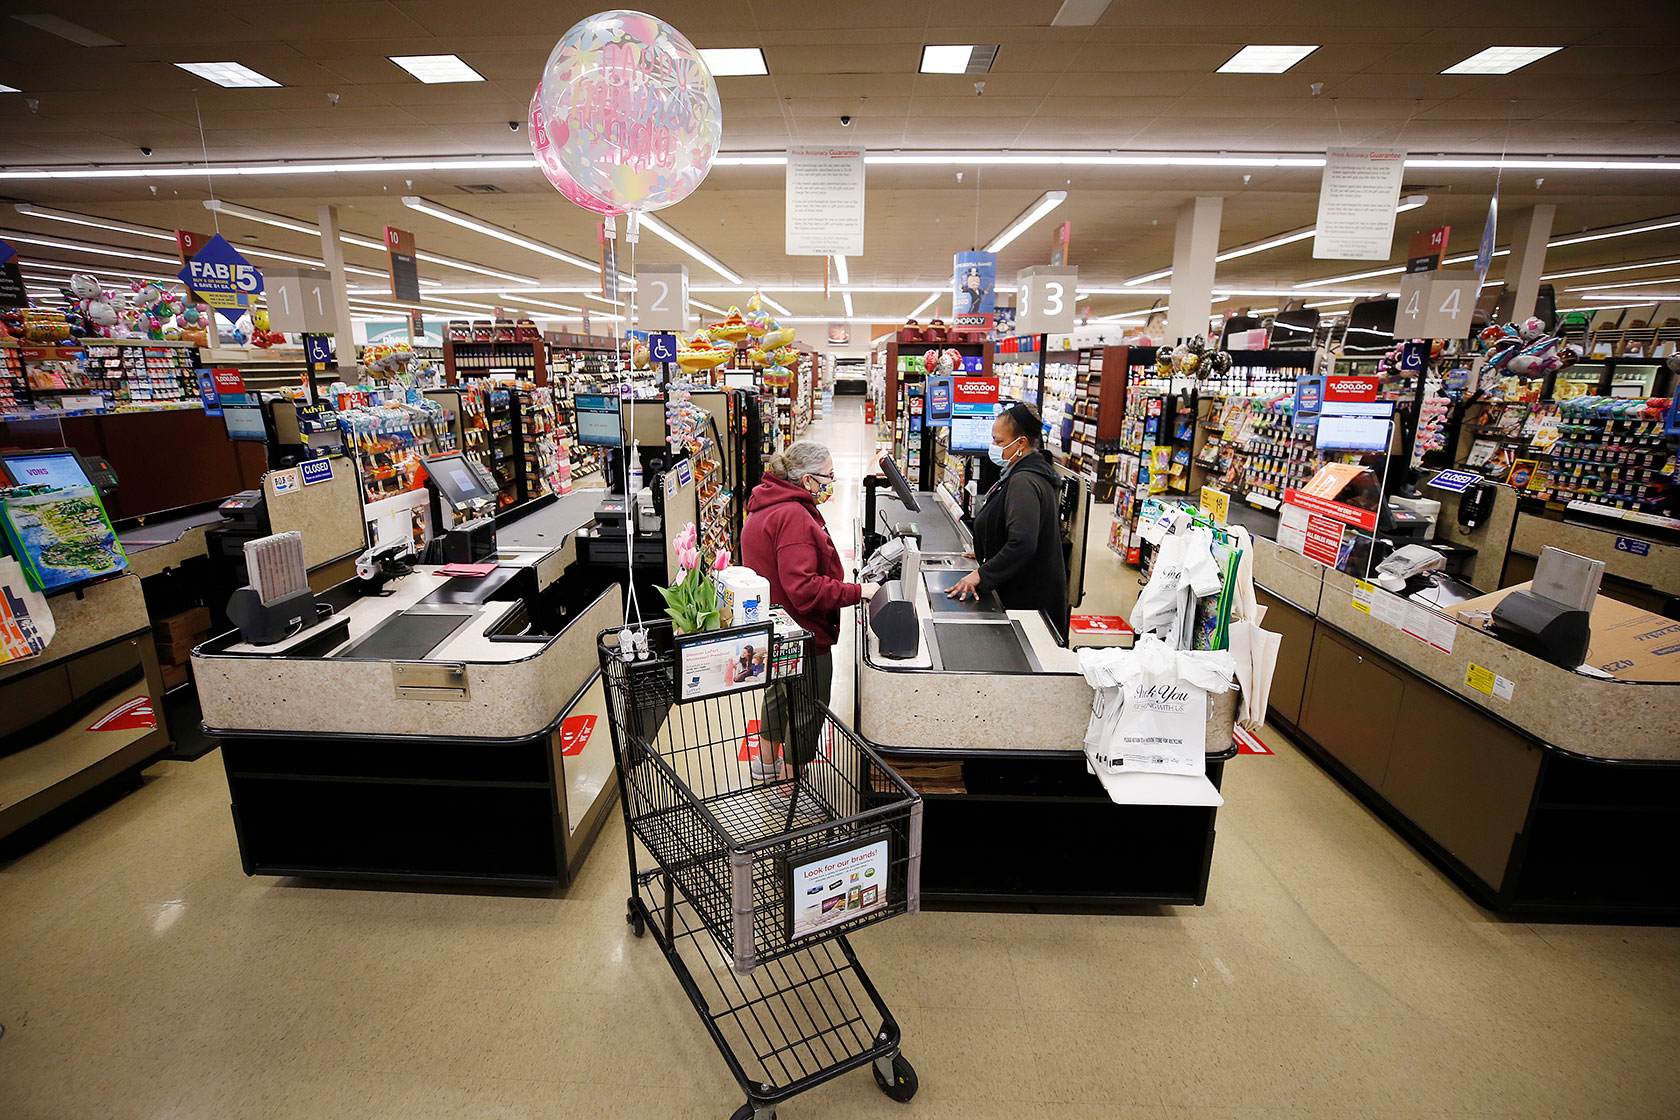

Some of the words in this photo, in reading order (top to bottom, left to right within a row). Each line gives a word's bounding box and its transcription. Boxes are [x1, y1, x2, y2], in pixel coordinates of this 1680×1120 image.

[184, 235, 192, 247] 9
[390, 231, 399, 244] 10
[1431, 232, 1442, 245] 14
[278, 285, 289, 315] 1
[312, 286, 322, 316] 1
[650, 280, 669, 312] 2
[1020, 284, 1028, 317] 3
[1043, 282, 1064, 316] 3
[1440, 288, 1461, 319] 4
[1405, 290, 1420, 319] 4
[302, 404, 326, 414] Advil
[26, 468, 50, 476] VONS
[304, 462, 328, 474] CLOSED
[1440, 472, 1472, 484] CLOSED
[1315, 534, 1326, 544] SALES
[1326, 538, 1338, 548] FINAL
[686, 654, 709, 662] Montessori
[710, 651, 730, 660] Preschool
[1158, 684, 1188, 703] You
[803, 868, 822, 879] Look
[824, 863, 836, 872] for
[837, 859, 850, 868] our
[851, 848, 878, 864] brands!
